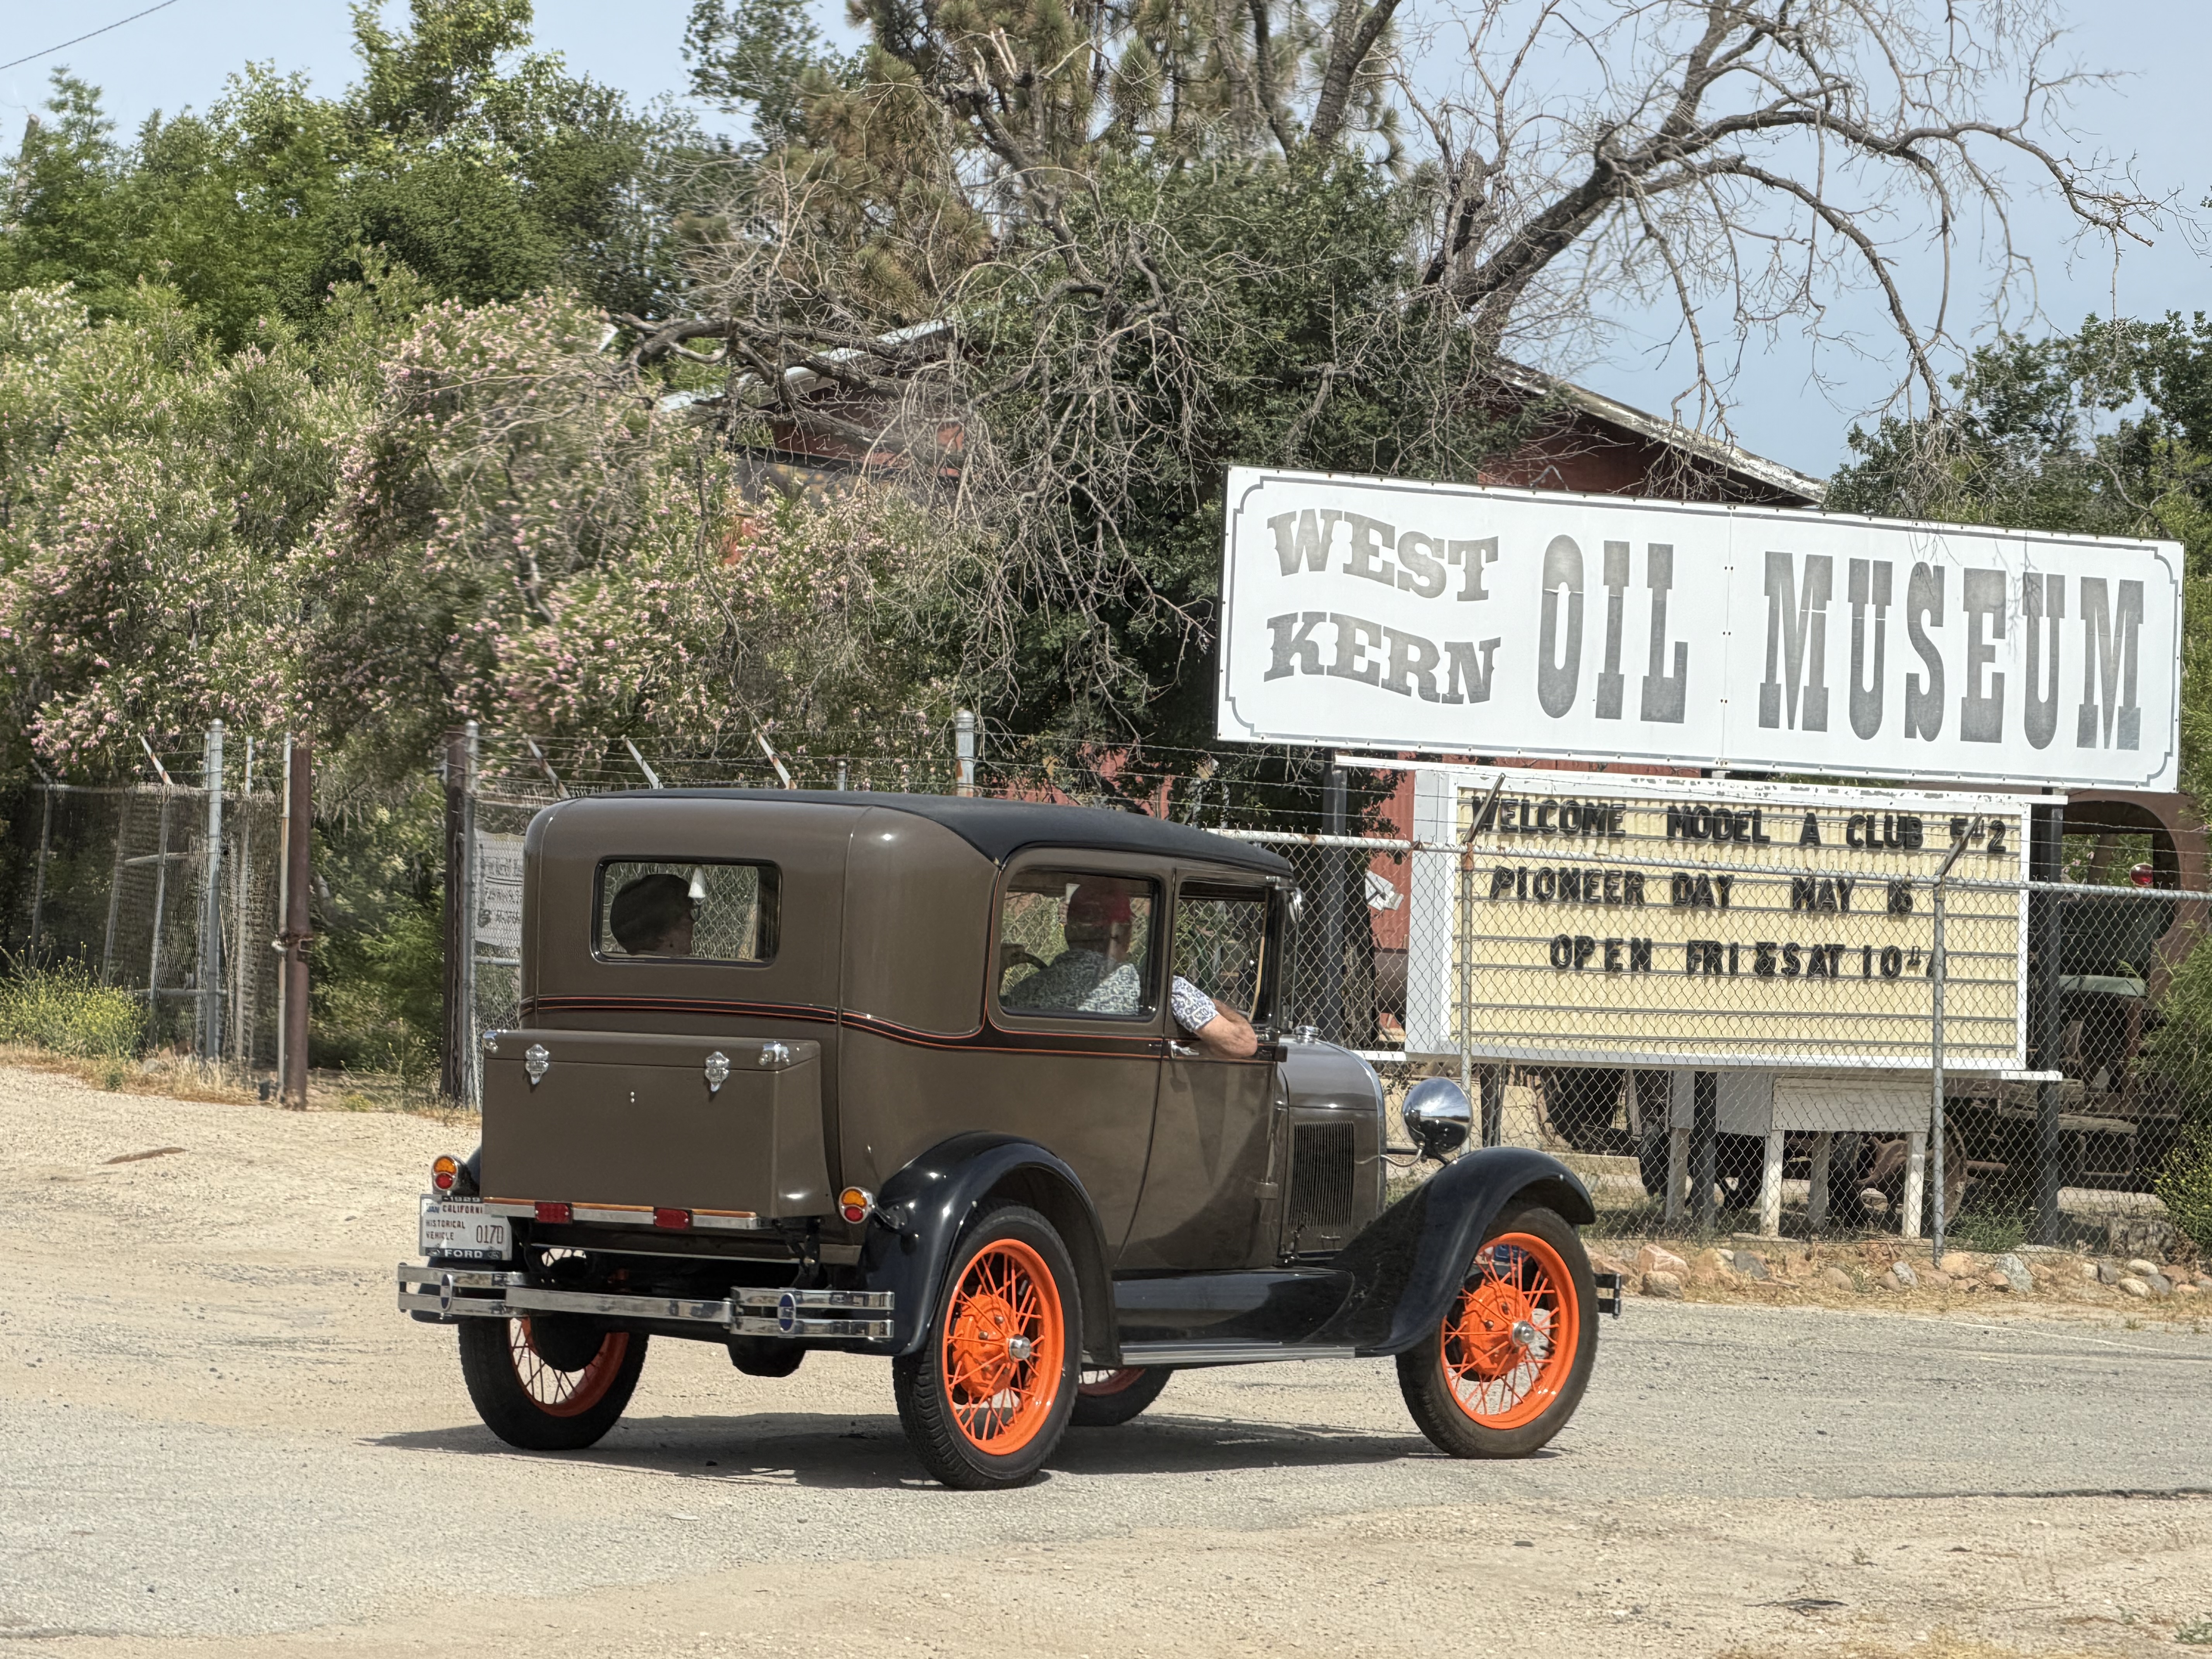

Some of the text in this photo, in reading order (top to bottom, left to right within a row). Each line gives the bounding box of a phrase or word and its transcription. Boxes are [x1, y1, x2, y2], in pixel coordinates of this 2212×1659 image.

[1267, 509, 1499, 602] WEST
[1263, 612, 1501, 704] KERN
[1537, 534, 2143, 751] OIL MUSEUM
[1471, 796, 1627, 838] WELCOME
[1667, 805, 1771, 843] MODEL
[1799, 812, 1822, 846] A
[1846, 814, 1924, 850] CLUB
[1489, 865, 1645, 905] PIONEER
[1671, 872, 1735, 908] DAY
[1792, 876, 1855, 912] MAY
[1550, 934, 1652, 973] OPEN
[1686, 940, 1739, 975] FRI
[426, 1219, 465, 1229] HISTORICAL
[443, 1205, 483, 1214] CALIFORNI
[426, 1231, 454, 1240] VEHICLE
[444, 1249, 483, 1258] FORD
